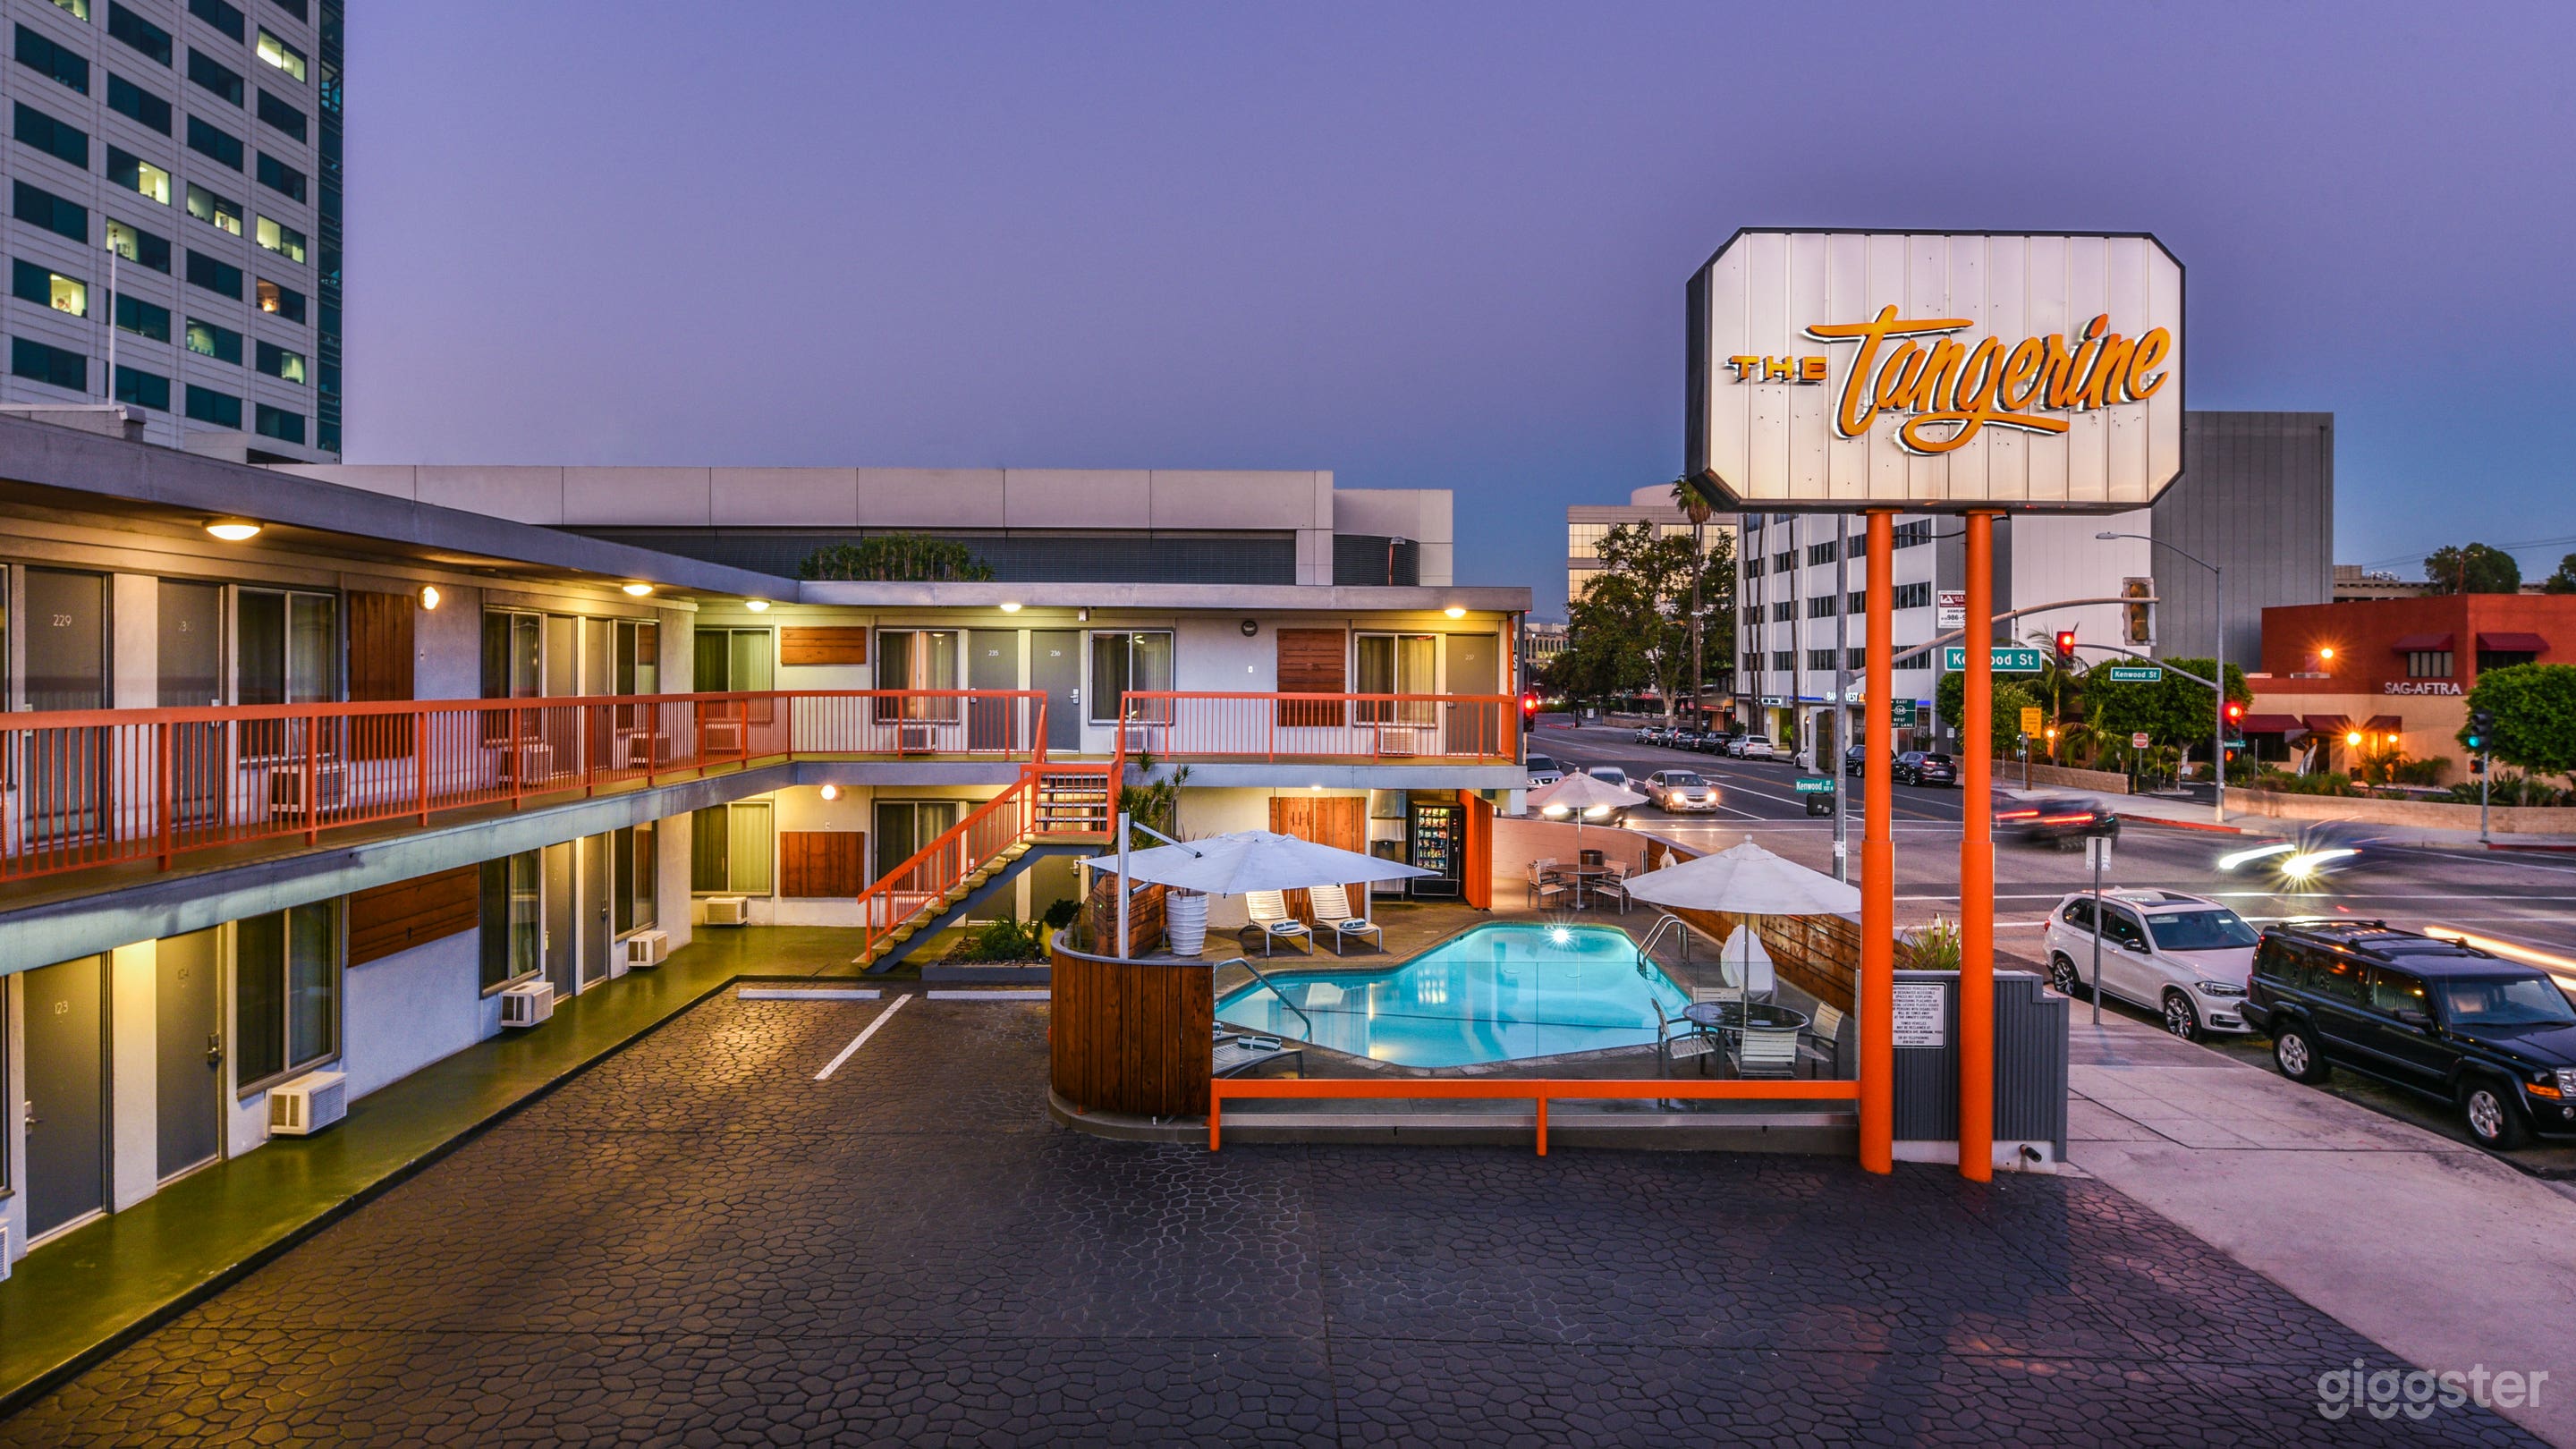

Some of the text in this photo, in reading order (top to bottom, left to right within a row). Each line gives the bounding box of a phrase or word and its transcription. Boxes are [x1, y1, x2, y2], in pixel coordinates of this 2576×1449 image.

[1729, 355, 1827, 382] THE
[53, 614, 72, 628] 229
[2019, 654, 2033, 665] St
[2385, 682, 2462, 695] SAG-AFTRA
[1796, 781, 1823, 791] Kenwood
[55, 1001, 69, 1014] 123
